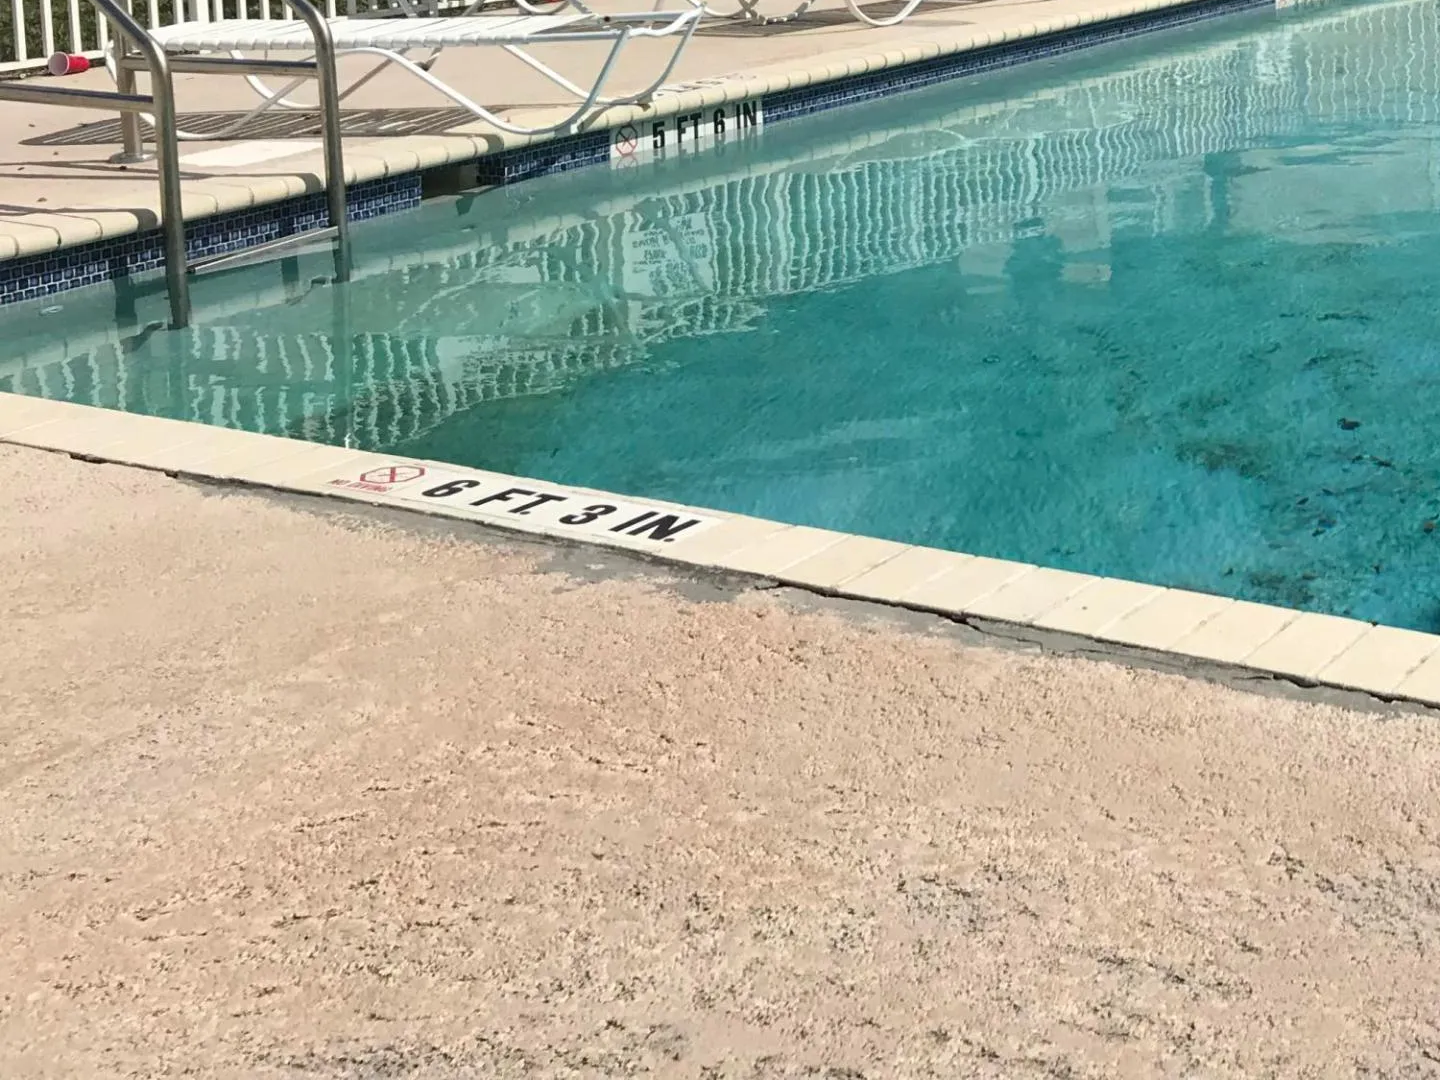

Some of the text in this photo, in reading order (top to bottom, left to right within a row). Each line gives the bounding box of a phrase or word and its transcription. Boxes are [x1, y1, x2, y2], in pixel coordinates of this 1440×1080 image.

[652, 100, 757, 149] 5 FT 6 IN
[421, 479, 481, 497] 6
[558, 504, 618, 525] 3
